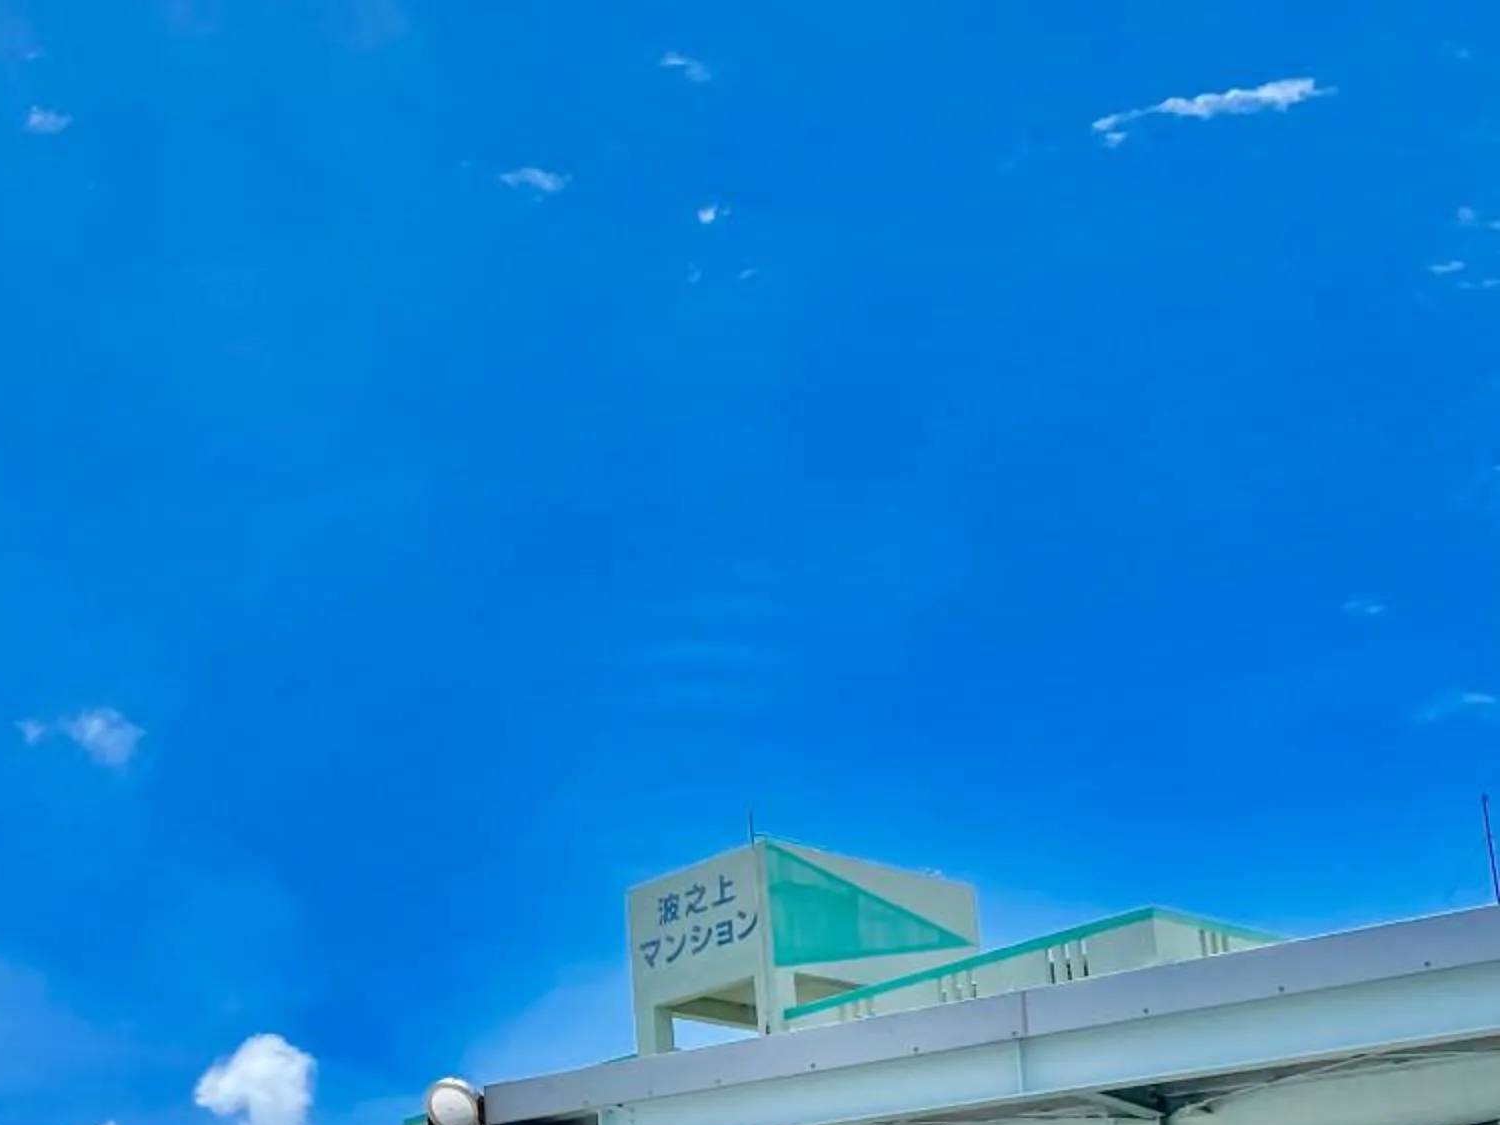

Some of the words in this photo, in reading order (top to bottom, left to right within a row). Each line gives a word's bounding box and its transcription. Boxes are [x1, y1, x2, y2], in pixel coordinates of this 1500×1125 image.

[658, 874, 737, 926] 波之上
[639, 912, 759, 969] マンション
